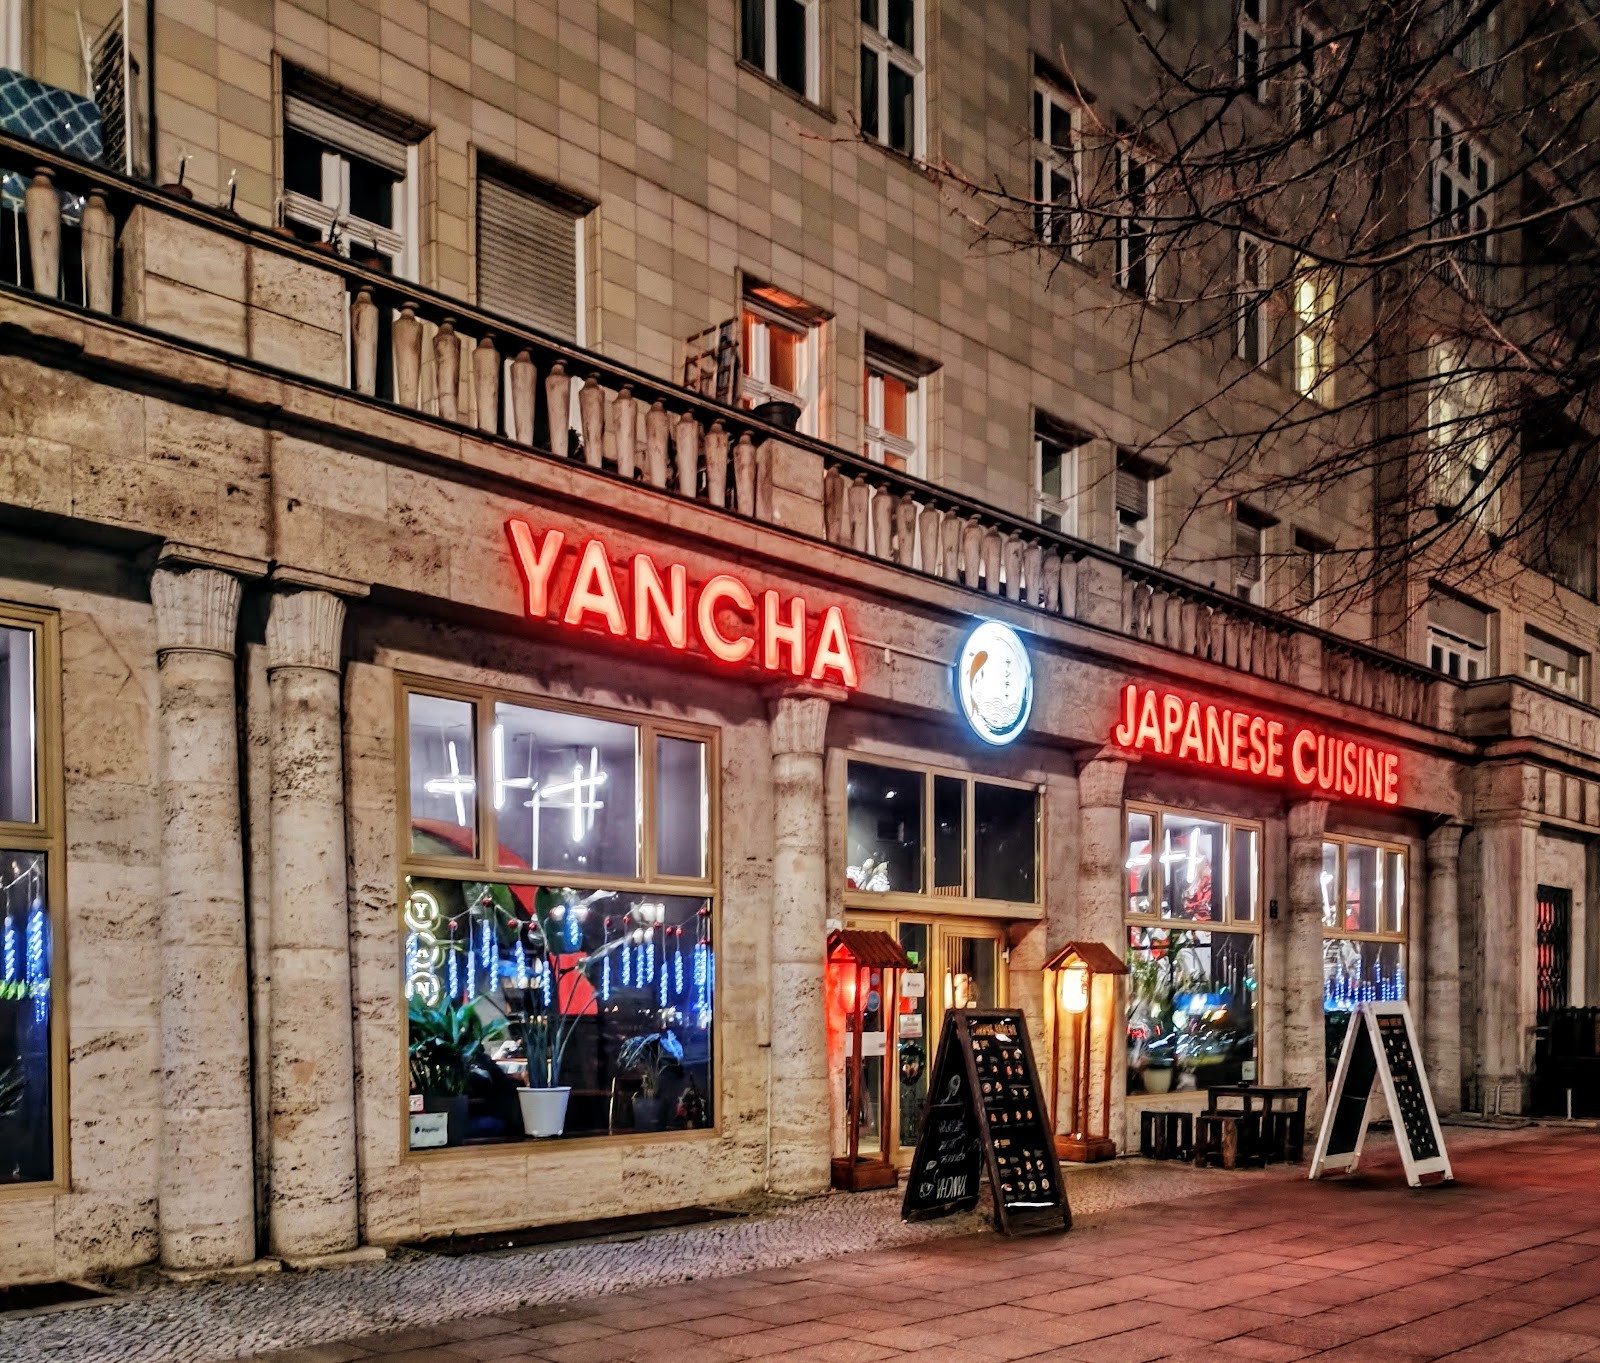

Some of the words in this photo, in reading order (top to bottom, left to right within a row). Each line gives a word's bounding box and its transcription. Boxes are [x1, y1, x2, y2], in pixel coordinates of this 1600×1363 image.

[506, 519, 858, 688] YANCHA
[1113, 684, 1284, 778] JAPANESE
[1291, 729, 1398, 804] CUISINE
